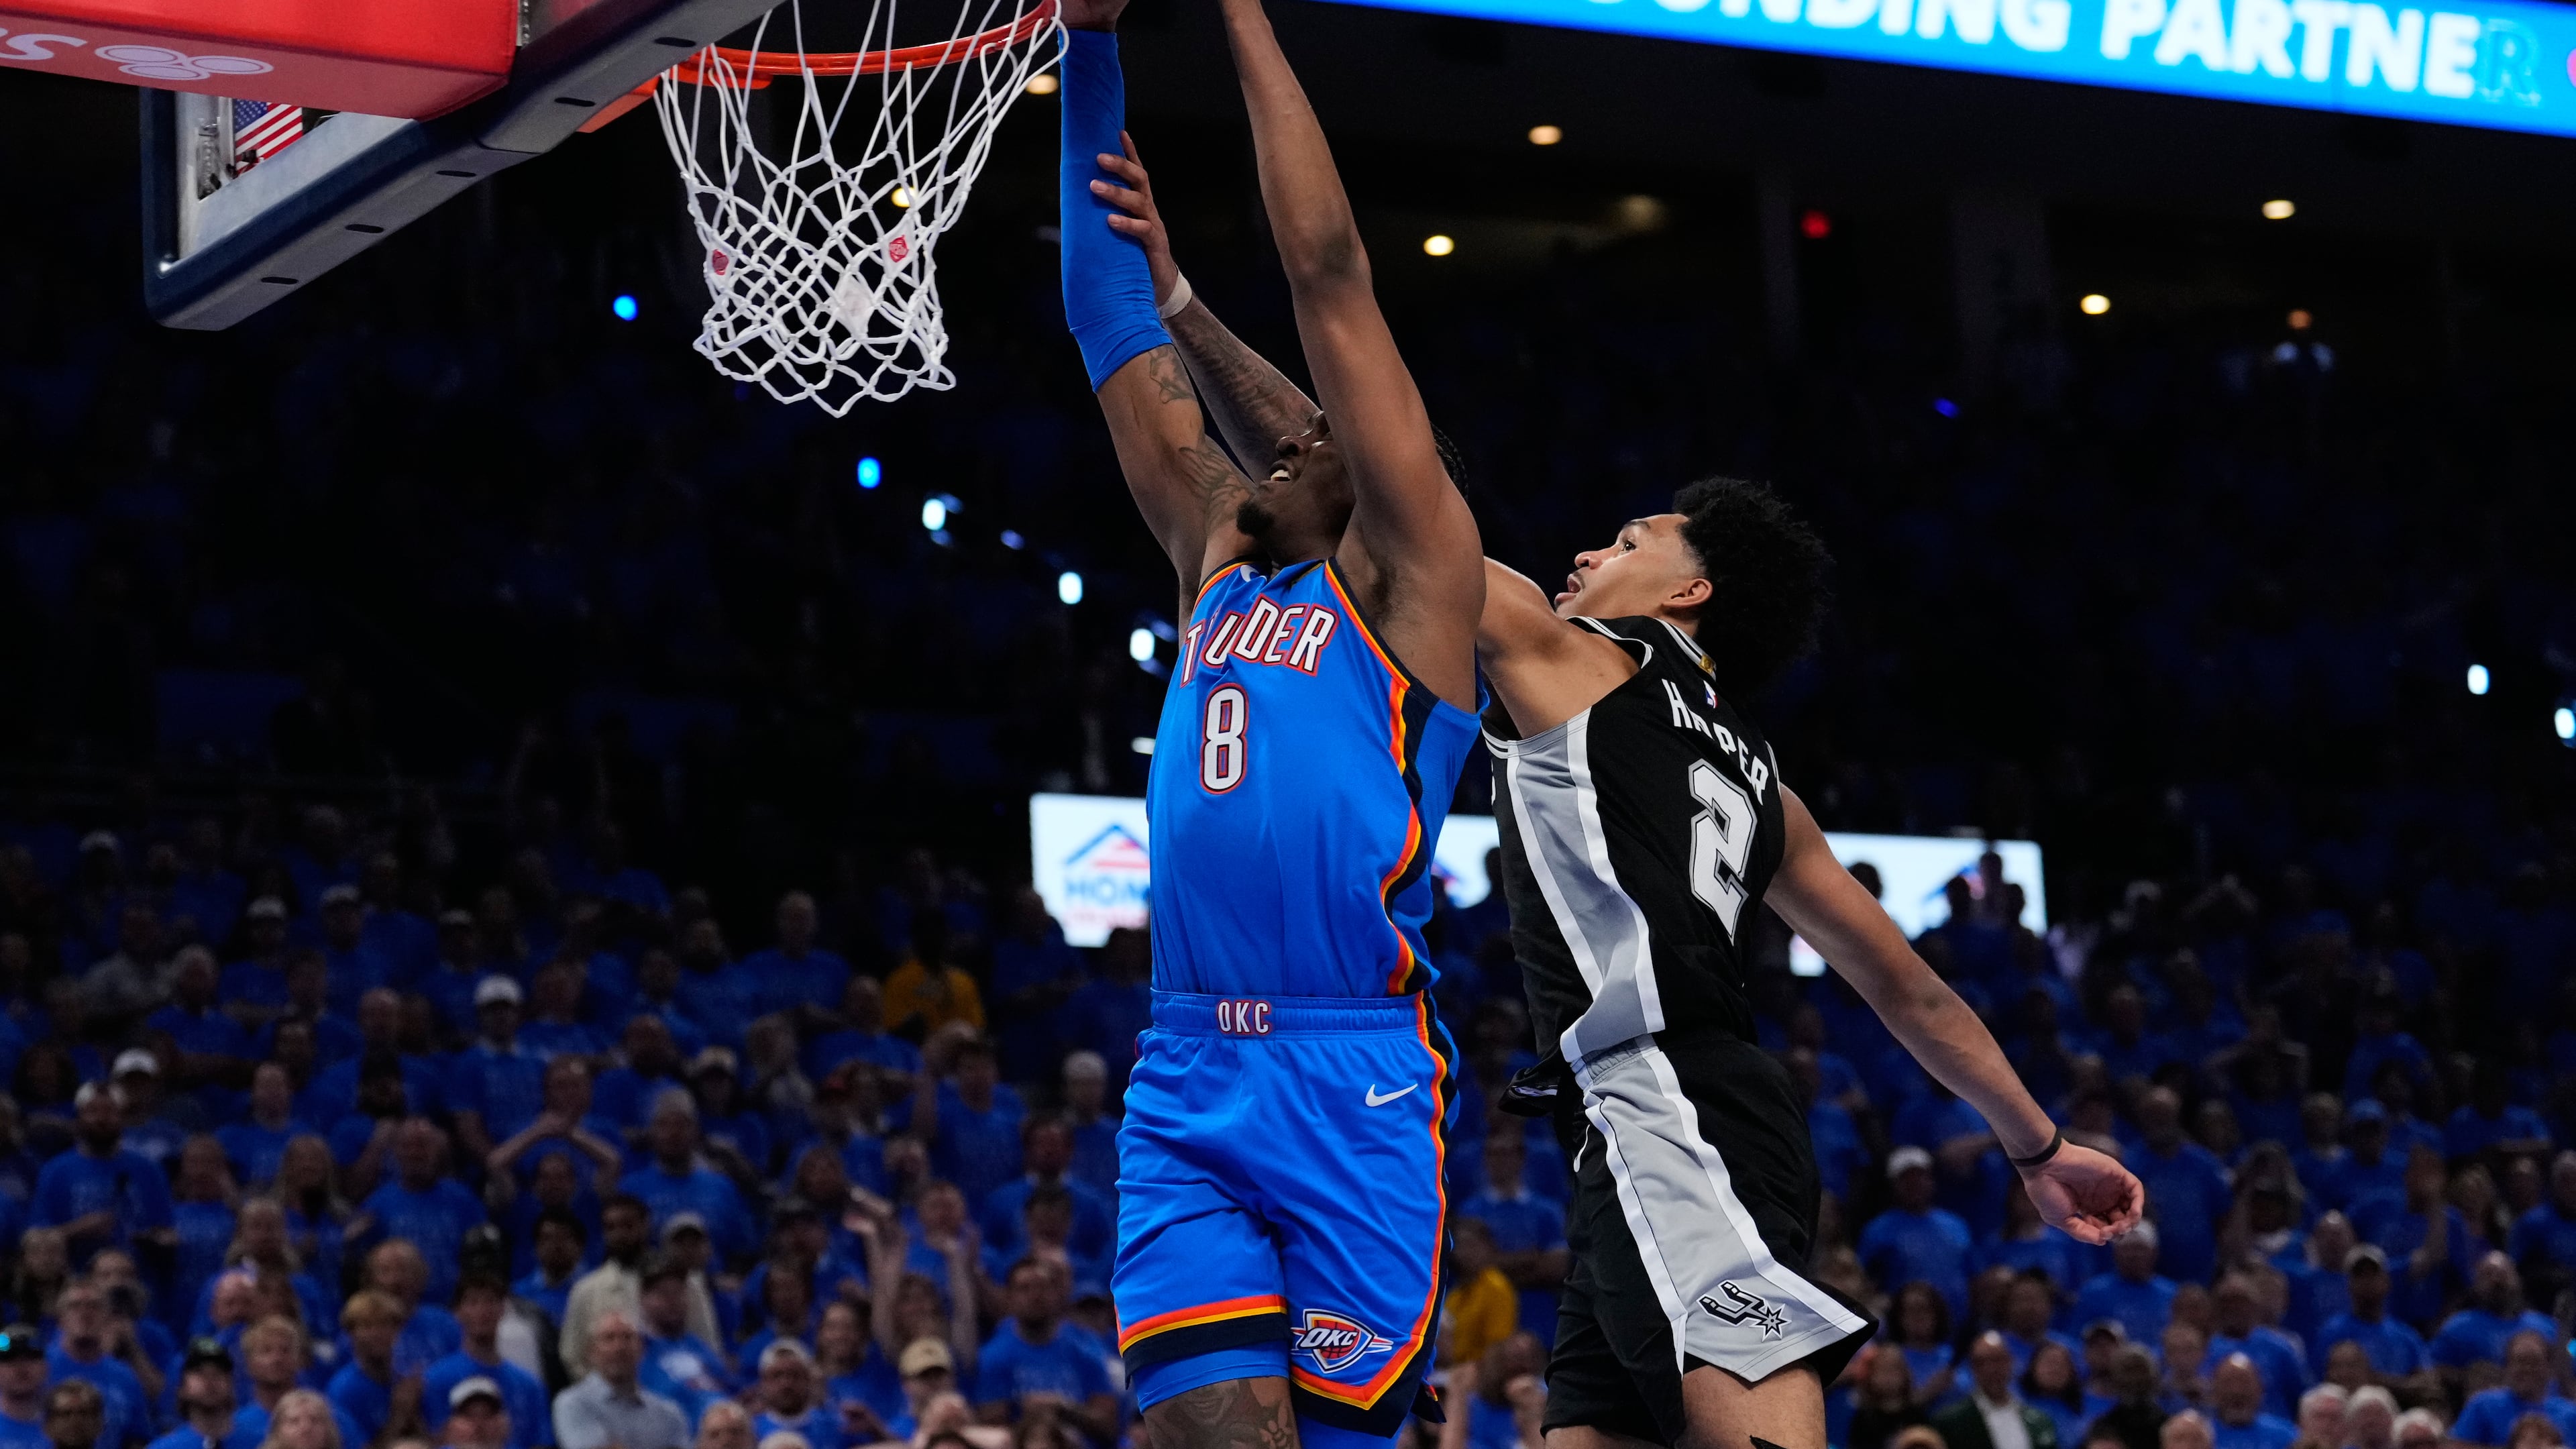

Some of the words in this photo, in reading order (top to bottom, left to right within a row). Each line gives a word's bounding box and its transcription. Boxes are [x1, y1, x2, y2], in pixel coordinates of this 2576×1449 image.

[2100, 0, 2542, 107] PARTNER
[1180, 593, 1340, 690] TUDER
[1199, 682, 1249, 794] 8
[1688, 758, 1758, 946] 2
[1216, 1000, 1271, 1035] OKC
[1299, 1328, 1358, 1348] OKC
